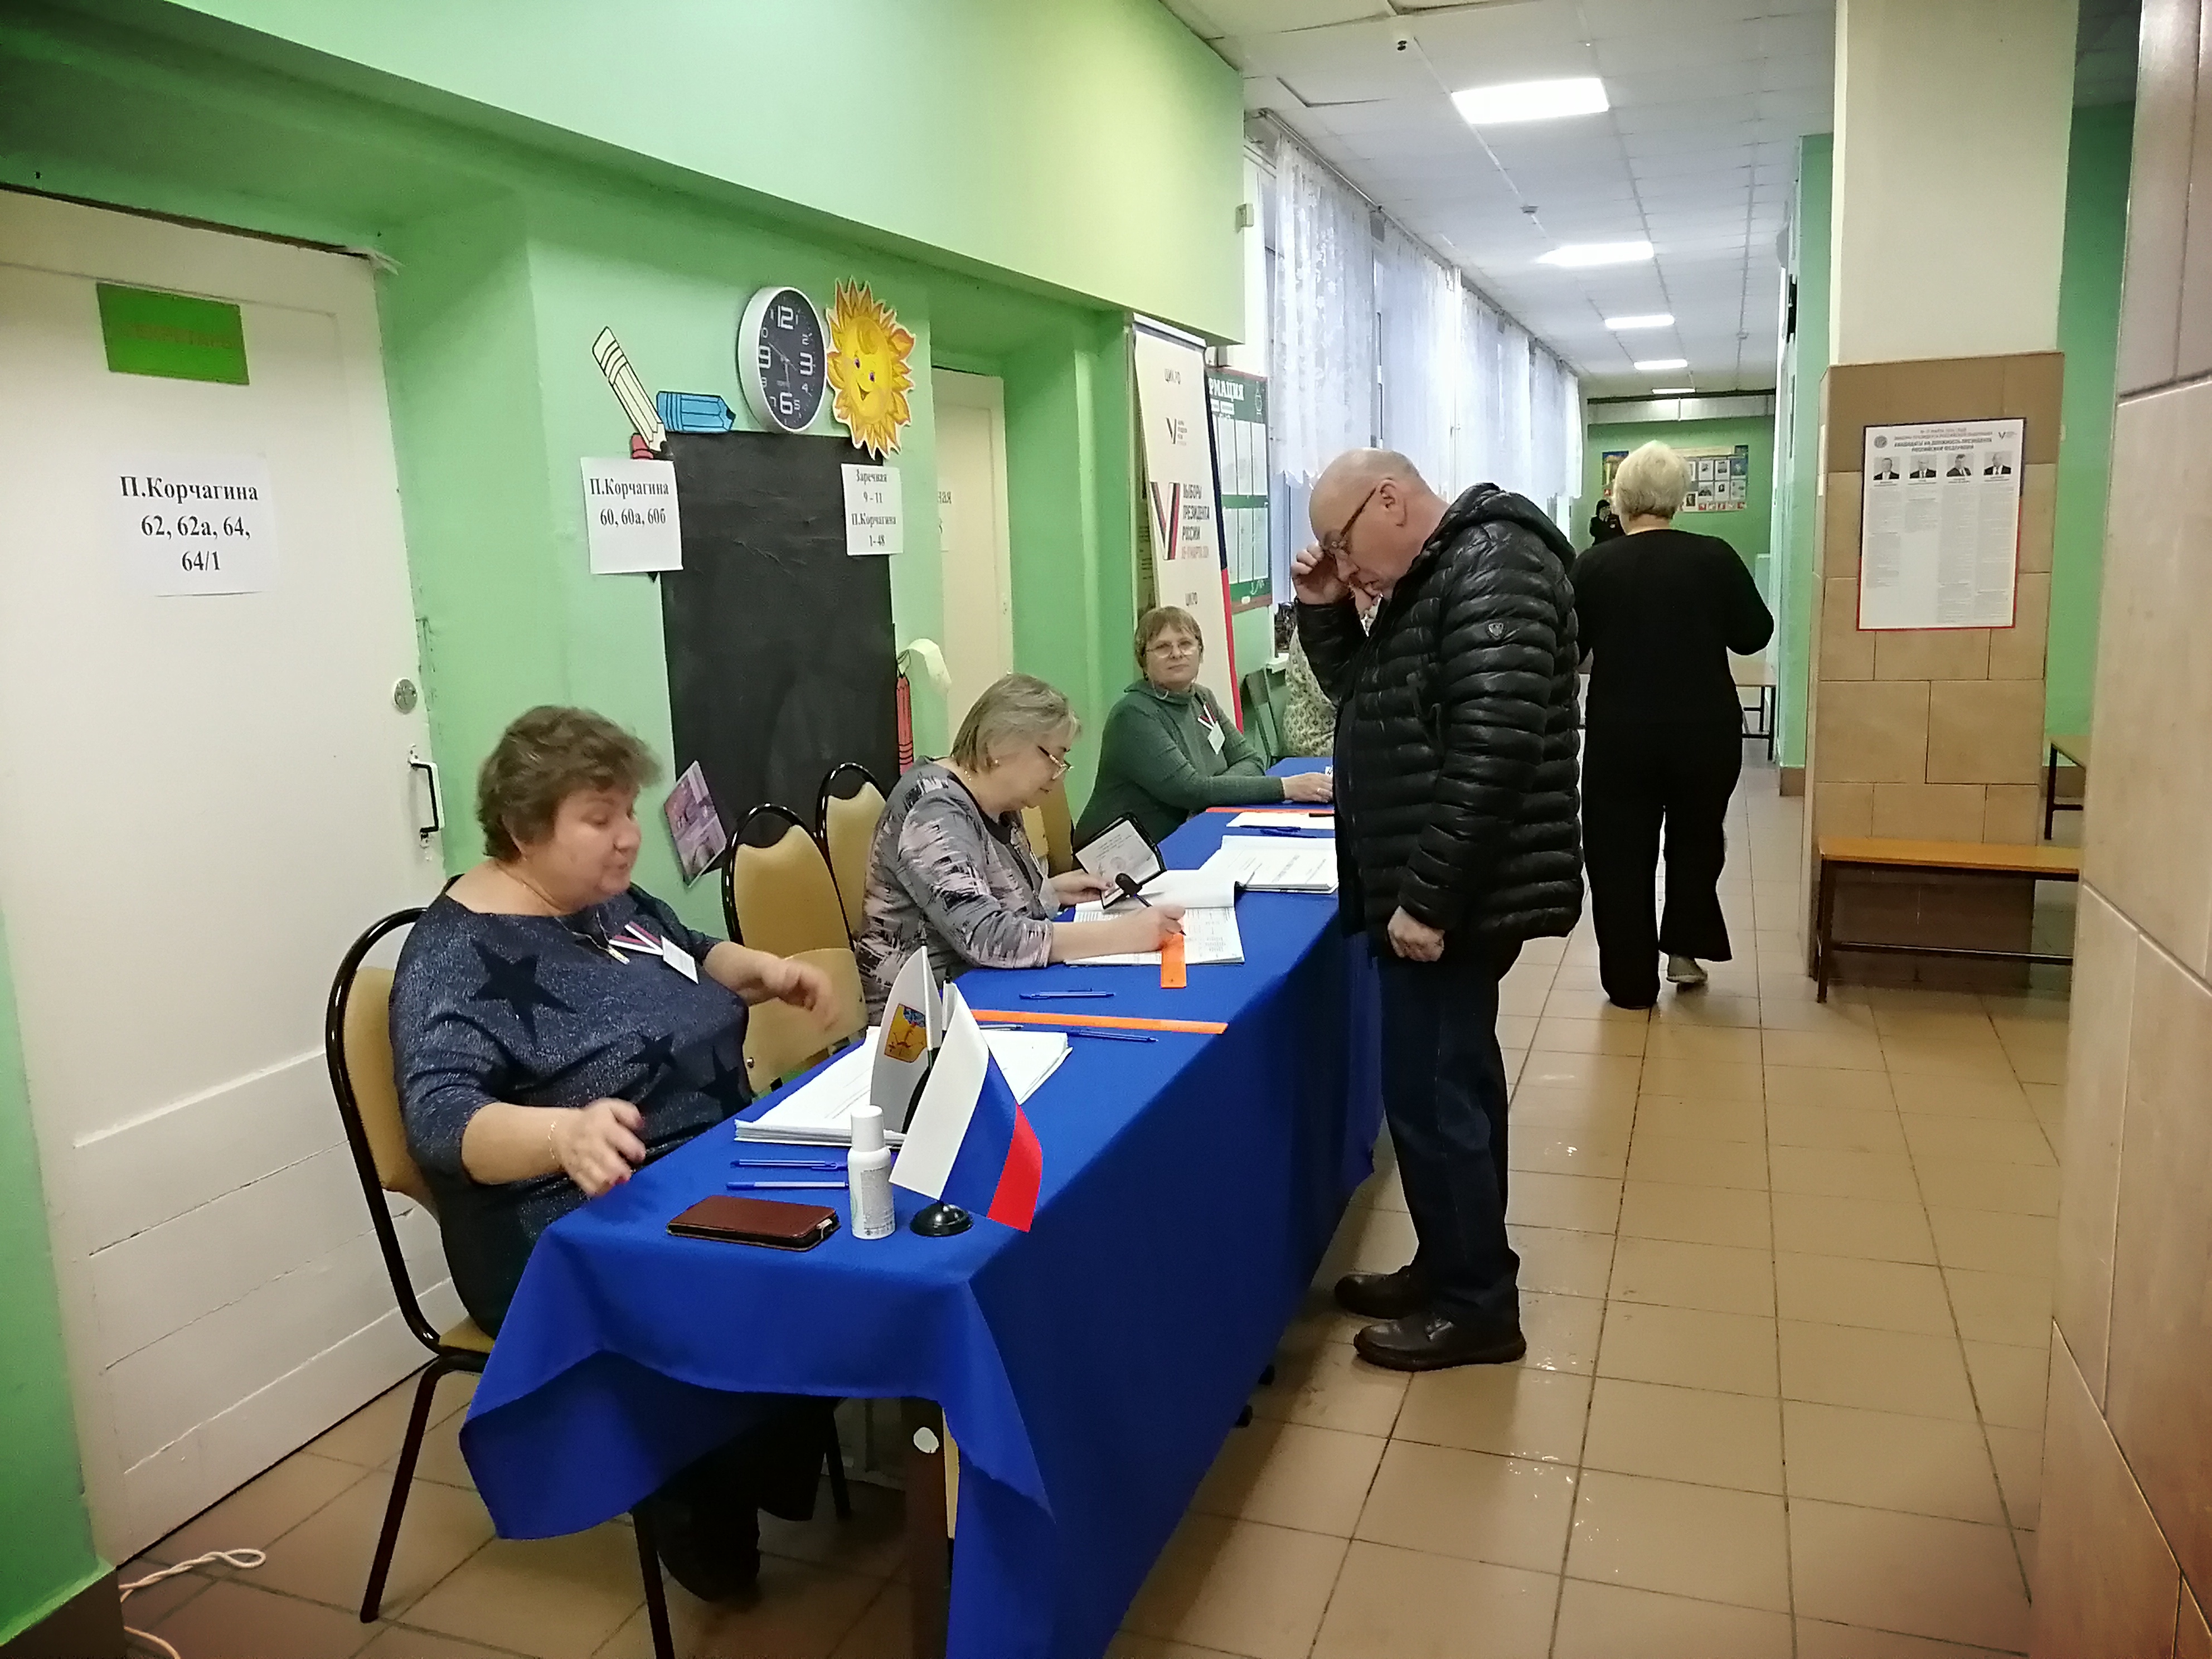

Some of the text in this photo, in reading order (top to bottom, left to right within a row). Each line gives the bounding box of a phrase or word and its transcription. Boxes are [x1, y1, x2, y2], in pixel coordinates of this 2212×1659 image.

[777, 305, 793, 329] 12
[802, 333, 809, 346] 2
[759, 345, 772, 369] 9
[799, 352, 813, 376] 3
[802, 382, 808, 394] 4
[769, 396, 777, 408] 7
[780, 392, 793, 415] 6
[793, 399, 801, 411] 5
[856, 469, 887, 485] Заречная
[120, 476, 258, 504] П.Корчагина
[590, 478, 670, 499] П.Корчагина
[875, 492, 882, 503] 11
[600, 508, 666, 527] 60, 60а, 60б
[851, 513, 896, 527] П.Корчагина
[141, 515, 251, 540] 62, 62а, 64,
[182, 551, 220, 571] 64/1
